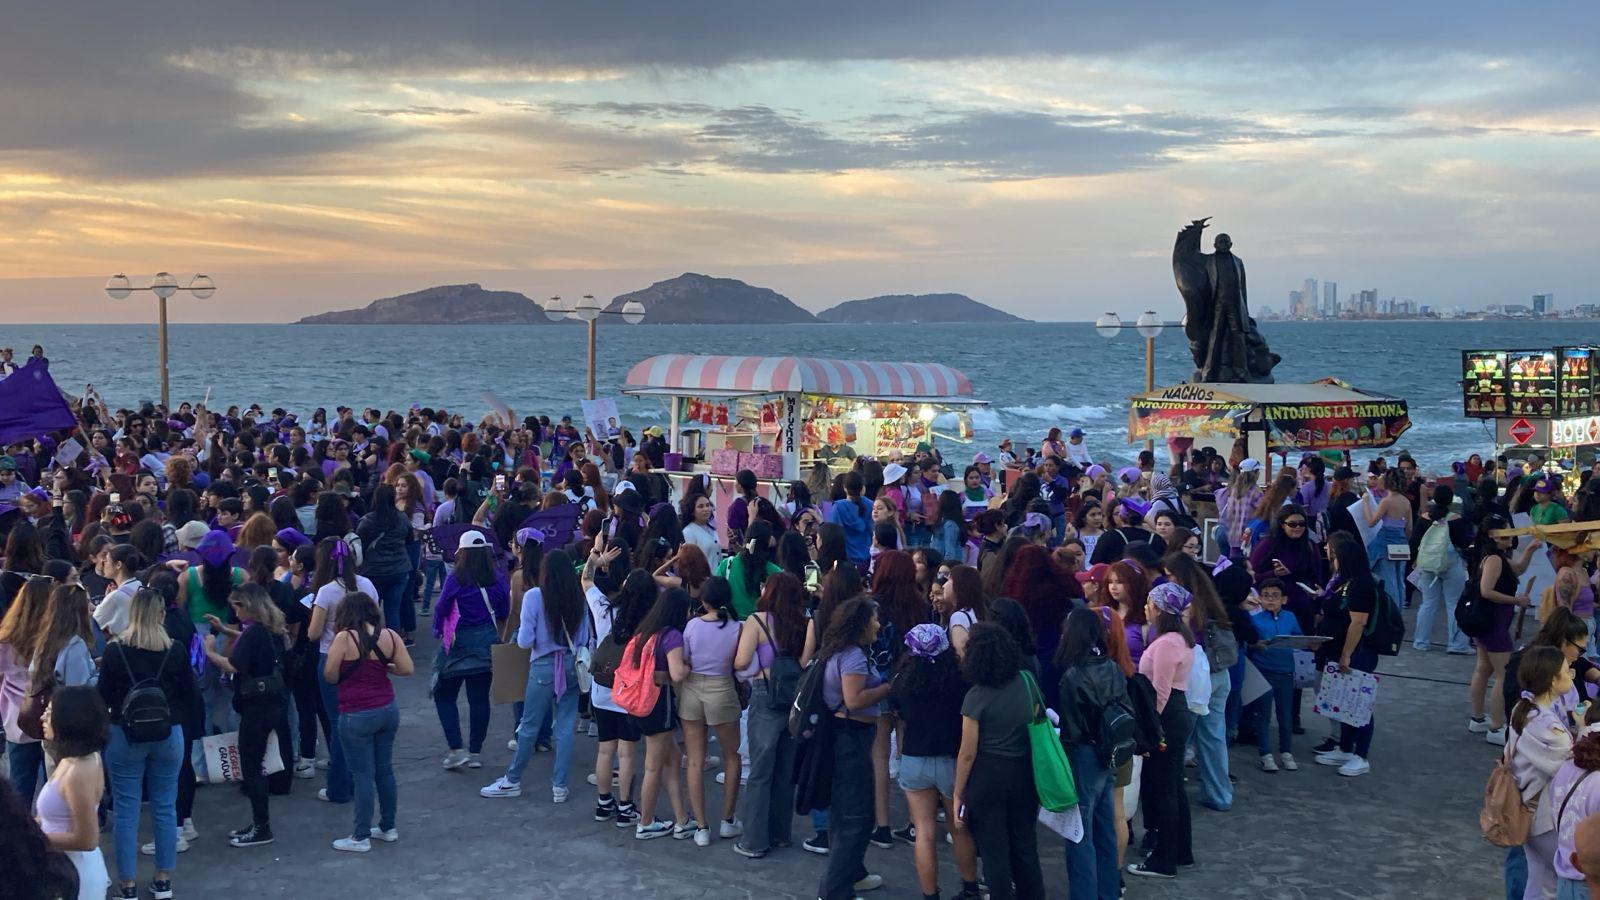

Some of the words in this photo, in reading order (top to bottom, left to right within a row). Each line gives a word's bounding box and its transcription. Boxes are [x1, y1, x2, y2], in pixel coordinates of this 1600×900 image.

[1161, 385, 1214, 401] NACHOS
[1131, 400, 1187, 410] ANTOJITOS
[1264, 405, 1331, 420] ANTOJITOS
[1333, 406, 1349, 418] LA
[1352, 404, 1402, 418] PATRONA
